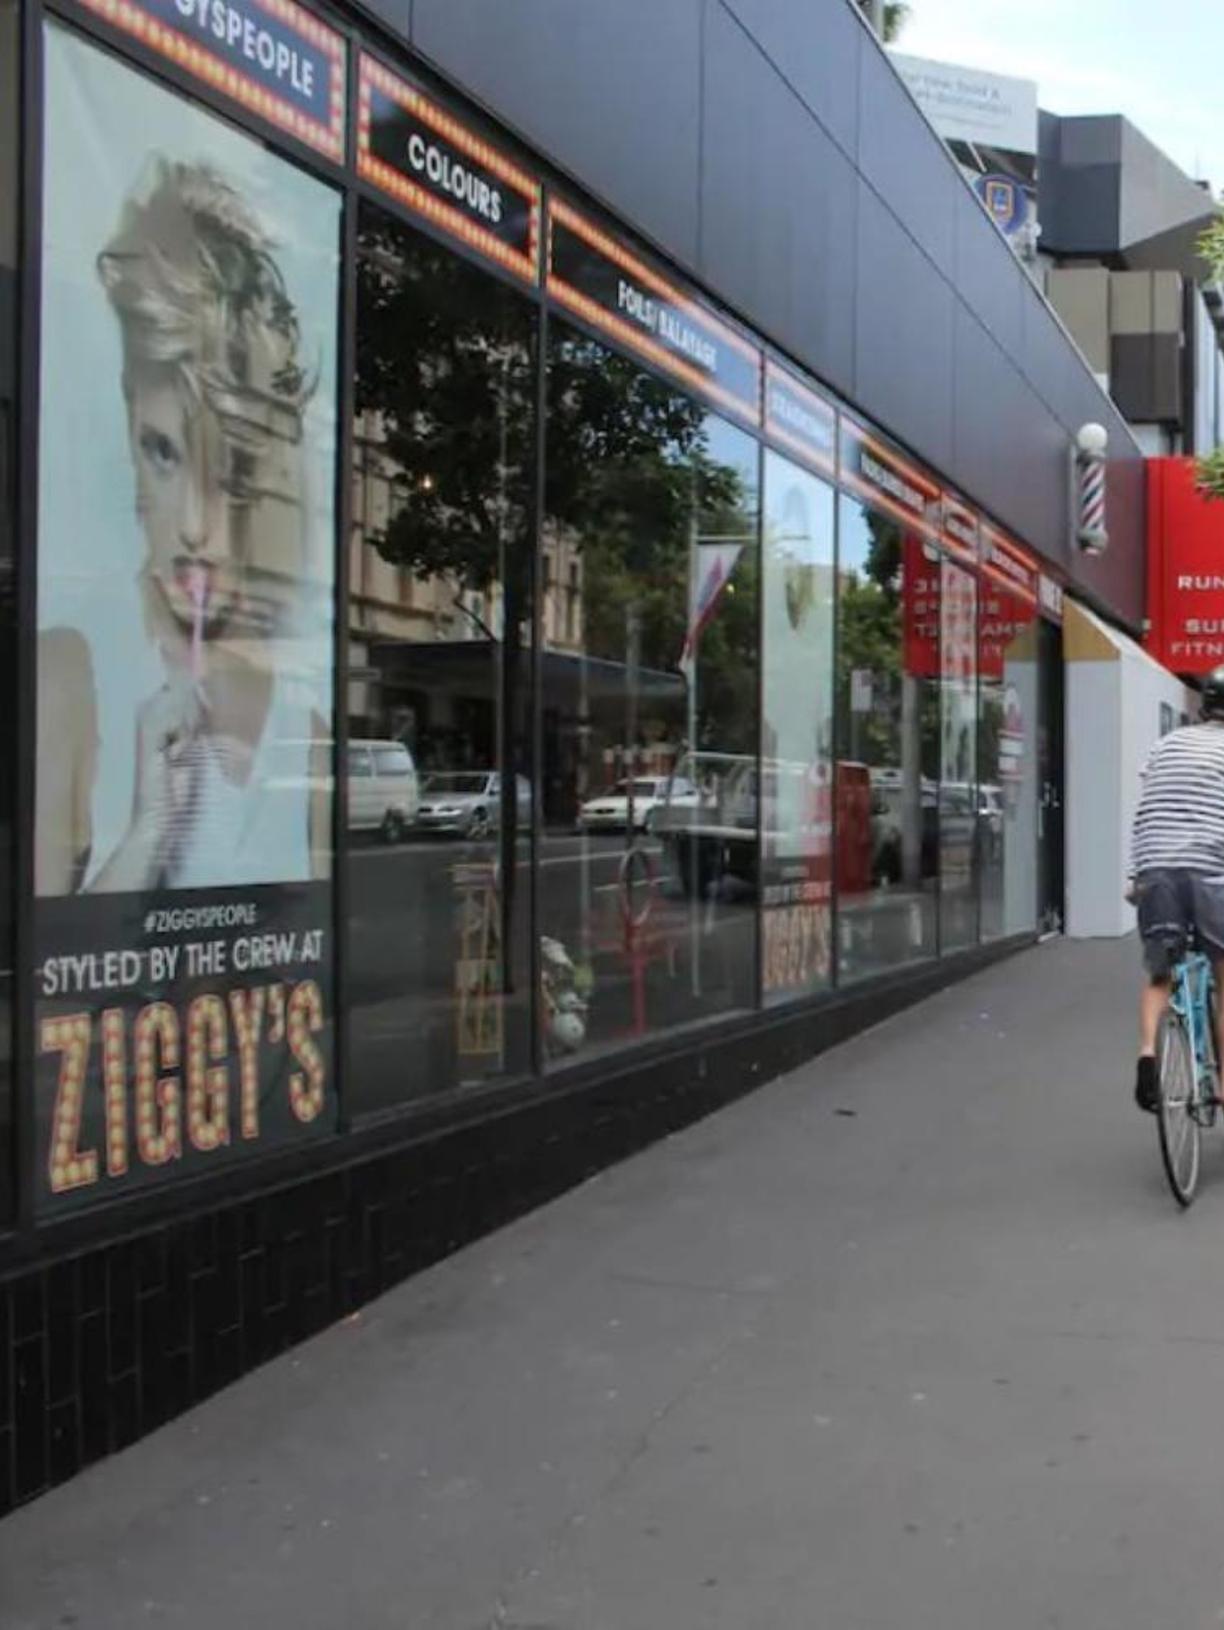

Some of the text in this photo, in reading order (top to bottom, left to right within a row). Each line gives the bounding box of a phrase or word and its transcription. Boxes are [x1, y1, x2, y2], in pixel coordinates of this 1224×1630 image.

[408, 133, 502, 223] COLOURS
[144, 903, 258, 933] #ZIGGYSPEOPLE
[42, 929, 324, 996] STYLED BY THE CREW AT
[40, 978, 325, 1194] ZIGGY'S
